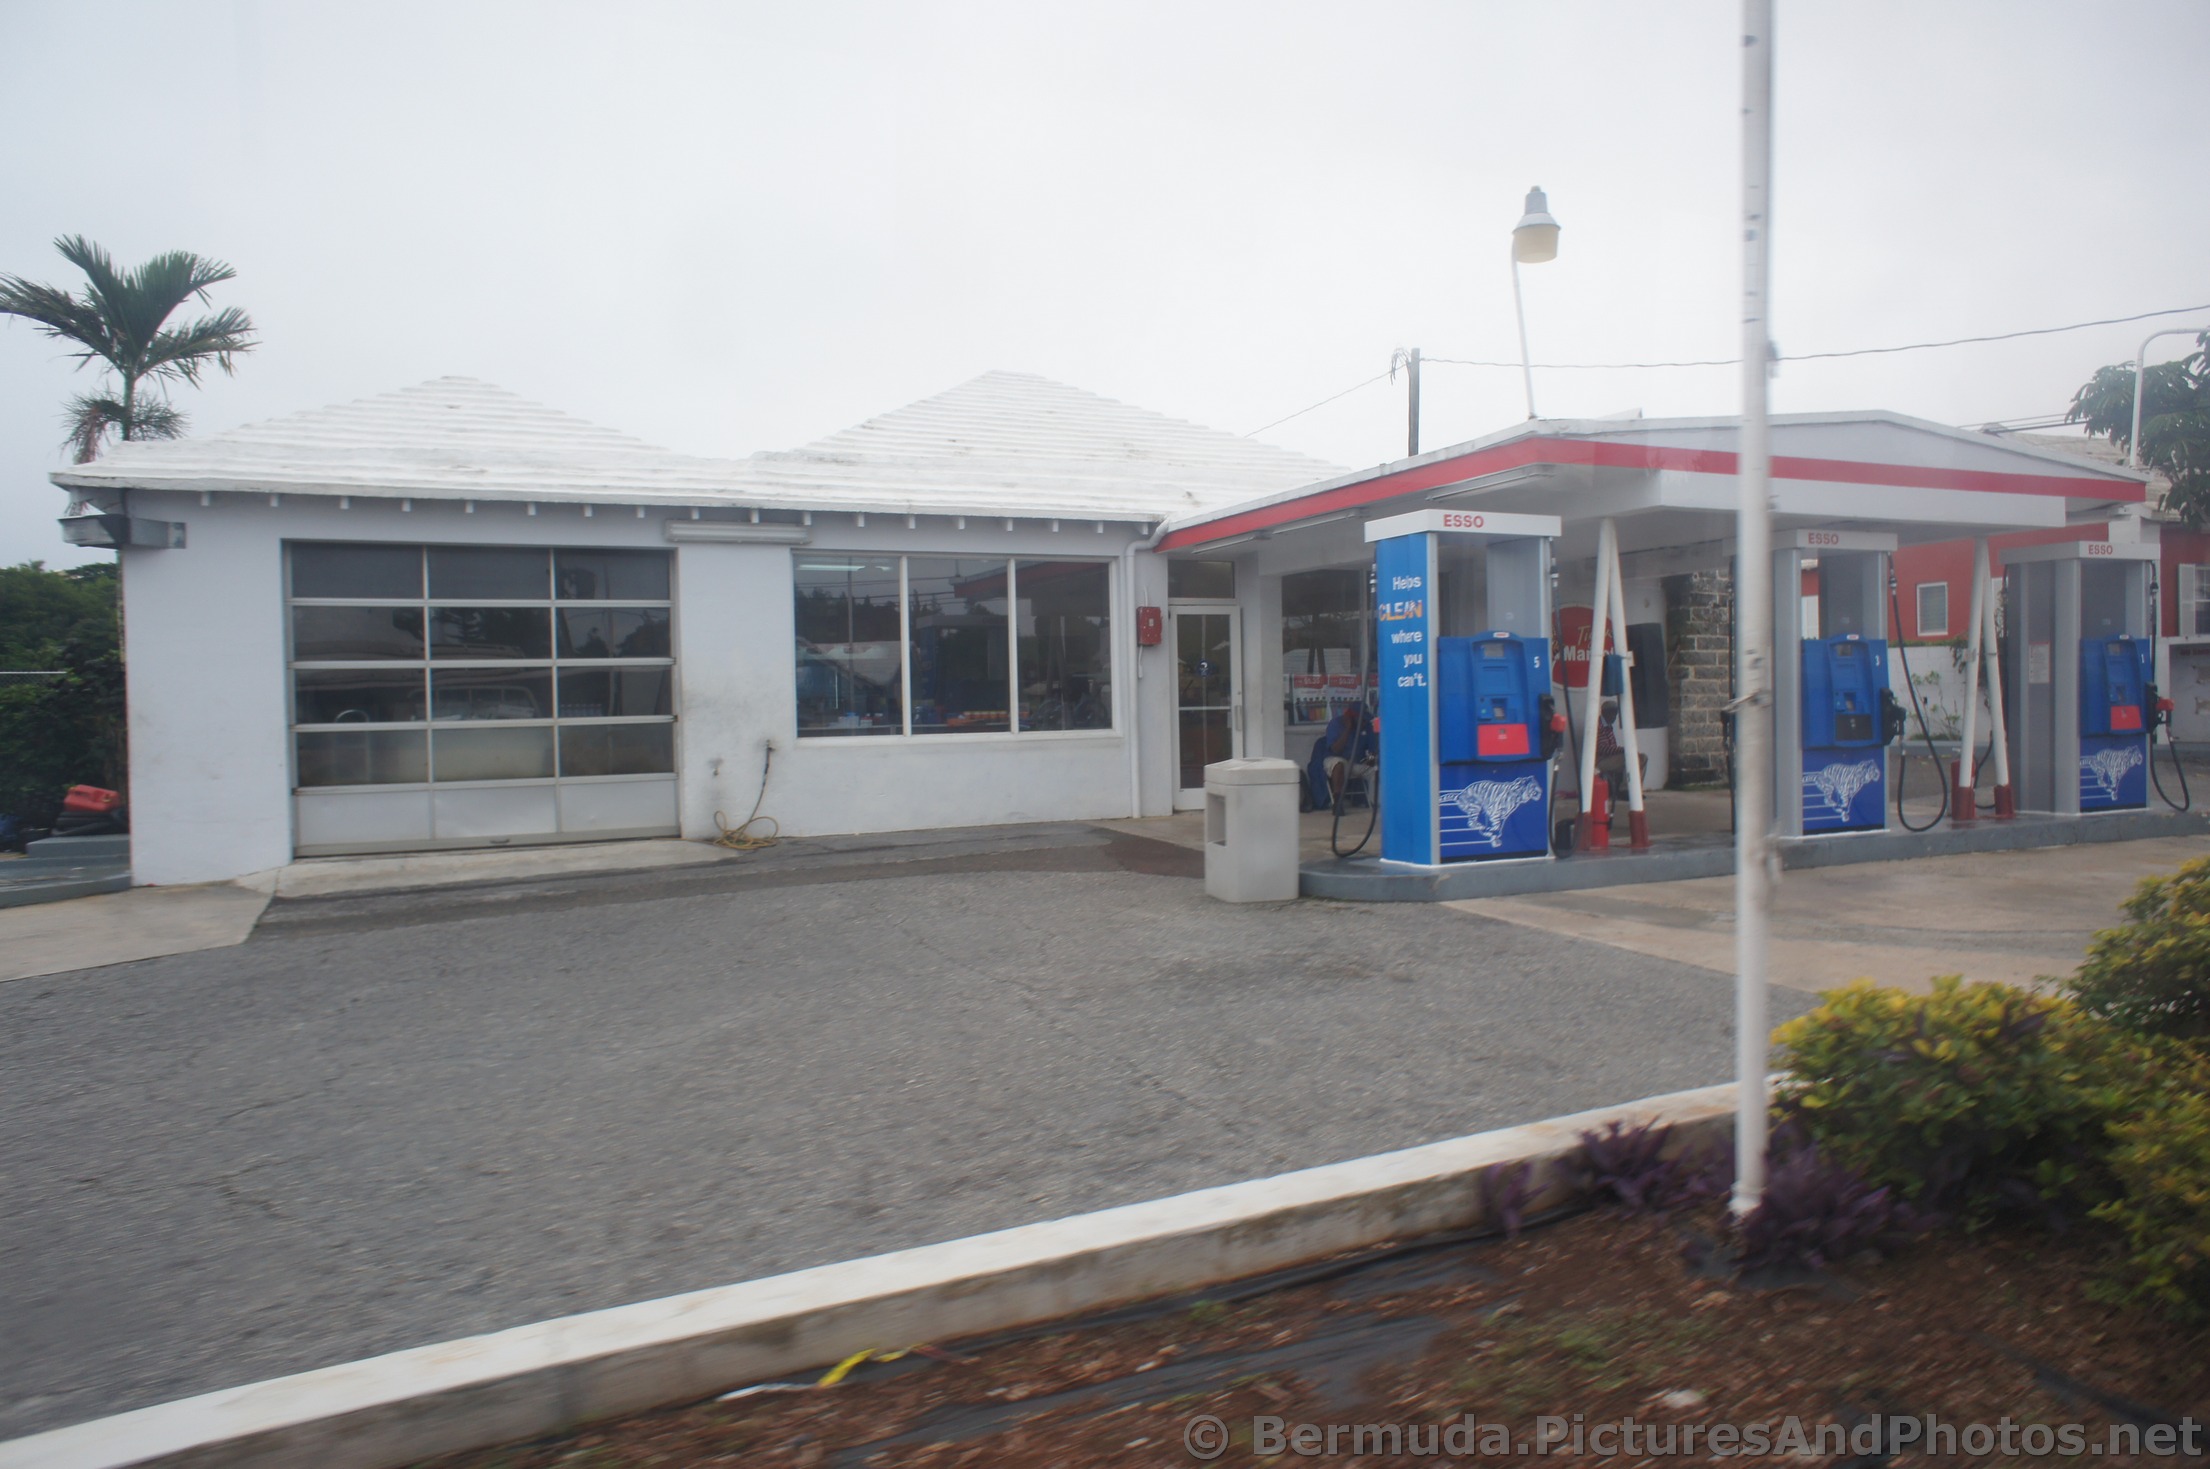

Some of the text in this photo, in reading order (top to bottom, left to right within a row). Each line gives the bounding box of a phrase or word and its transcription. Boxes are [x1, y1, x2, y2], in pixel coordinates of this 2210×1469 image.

[1443, 513, 1485, 528] ESSO
[1808, 532, 1840, 545] ESSO
[2088, 544, 2113, 555] ESSO
[1392, 576, 1422, 591] Helps
[1378, 600, 1423, 621] CLEAN
[1391, 630, 1423, 644] where
[1403, 653, 1423, 668] you
[1533, 655, 1541, 669] 5
[1397, 672, 1427, 687] can't.
